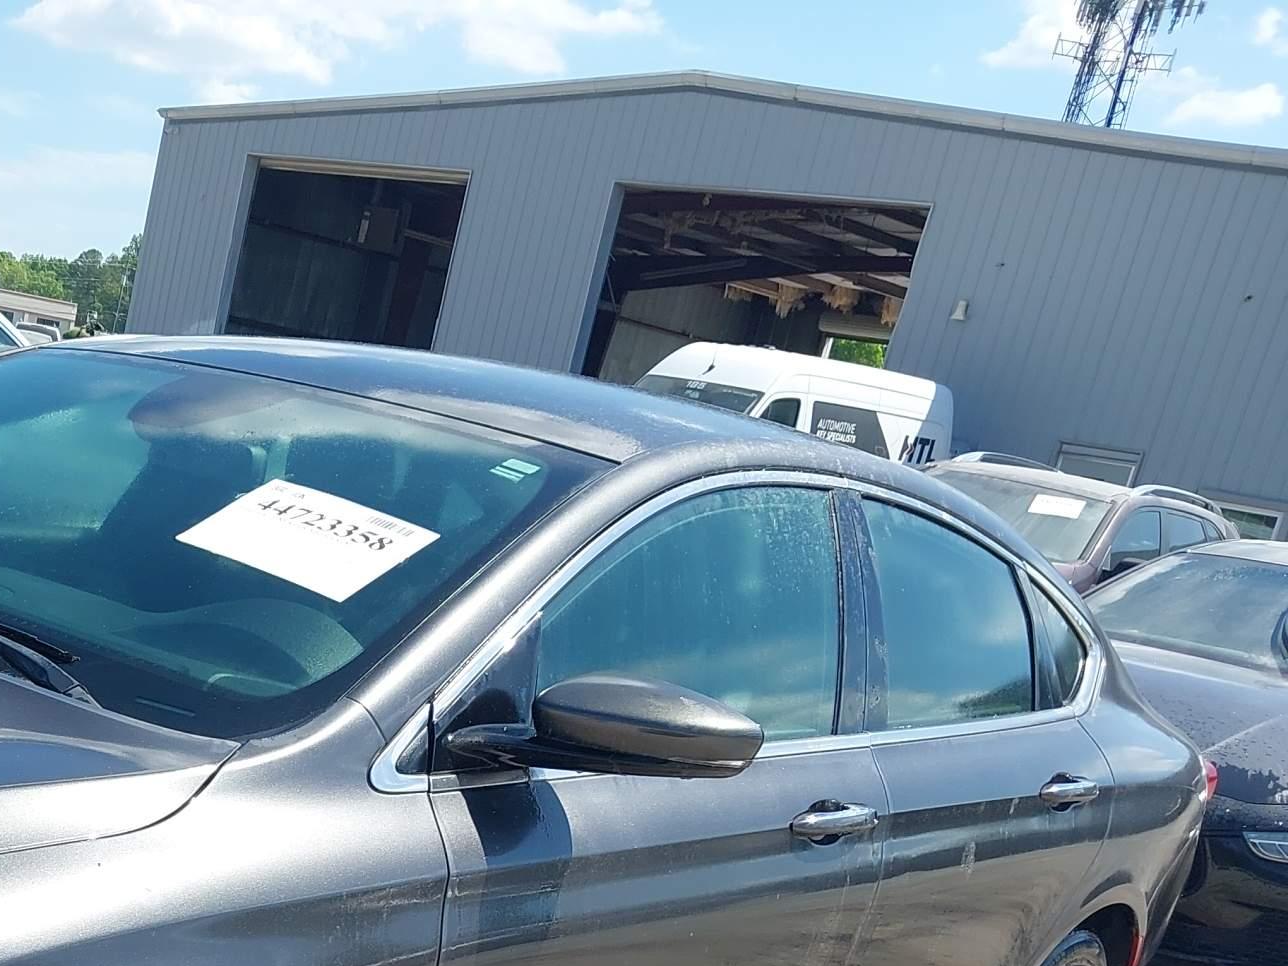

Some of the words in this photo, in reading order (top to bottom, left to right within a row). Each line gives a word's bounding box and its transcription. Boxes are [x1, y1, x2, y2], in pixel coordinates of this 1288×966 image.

[817, 418, 856, 434] AUTOMOTIVE
[825, 431, 856, 444] SPECIALISTS
[257, 499, 393, 550] 44723358
